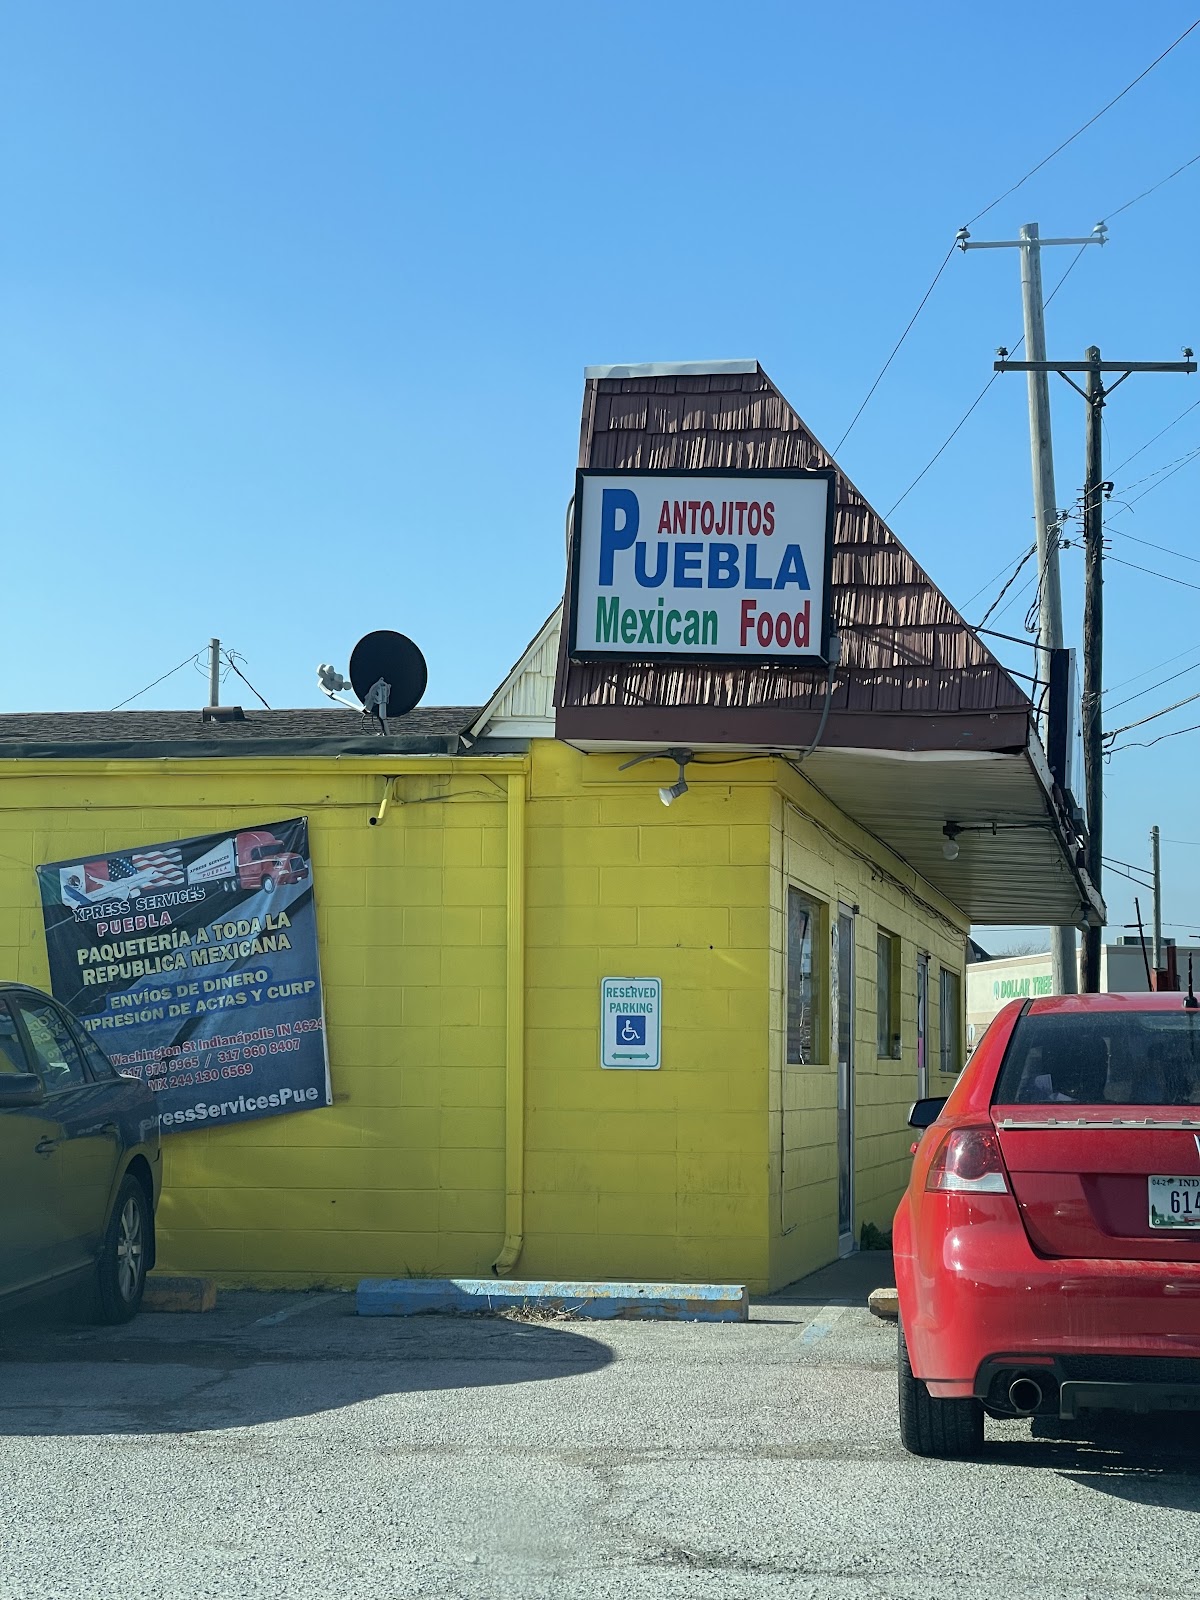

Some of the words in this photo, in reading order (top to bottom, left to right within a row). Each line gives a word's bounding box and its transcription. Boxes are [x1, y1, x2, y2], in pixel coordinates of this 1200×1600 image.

[657, 500, 775, 537] ANTOJITOS
[599, 488, 811, 590] PUEBLA
[595, 596, 718, 645] Mexican
[740, 599, 811, 648] Food
[202, 866, 228, 878] PUEBLA
[72, 900, 130, 922] XPRESS
[135, 888, 206, 912] SERVICES
[96, 911, 173, 937] PUEBLA
[77, 927, 192, 966] PAQUETERÍA
[196, 927, 210, 945] A
[212, 917, 262, 941] TODA
[265, 911, 292, 931] LA
[82, 953, 187, 986] REPUBLICA
[191, 933, 292, 967] MEXICANA
[81, 1006, 165, 1032] MPRESIÓN
[168, 1002, 192, 1018] DE
[195, 991, 248, 1014] ACTAS
[250, 989, 263, 1002] Y
[266, 980, 316, 1000] CURP
[110, 987, 173, 1010] ENVÍOS
[176, 982, 200, 998] DE
[203, 969, 269, 994] DINERO
[606, 986, 656, 998] RESERVED
[1001, 978, 1030, 999] DOLLAR
[1032, 975, 1053, 996] TREE
[609, 1002, 653, 1013] PARKING
[110, 1044, 181, 1067] Washington
[182, 1040, 197, 1054] St
[198, 1030, 275, 1052] Indianápolis
[276, 1022, 291, 1036] IN
[145, 1061, 168, 1077] 974
[169, 1055, 200, 1072] 9965
[218, 1049, 240, 1064] 317
[243, 1043, 267, 1059] 960
[268, 1038, 300, 1055] 8407
[147, 1077, 169, 1092] MX
[170, 1074, 193, 1089] 244
[195, 1068, 219, 1084] 130
[221, 1062, 254, 1078] 6569
